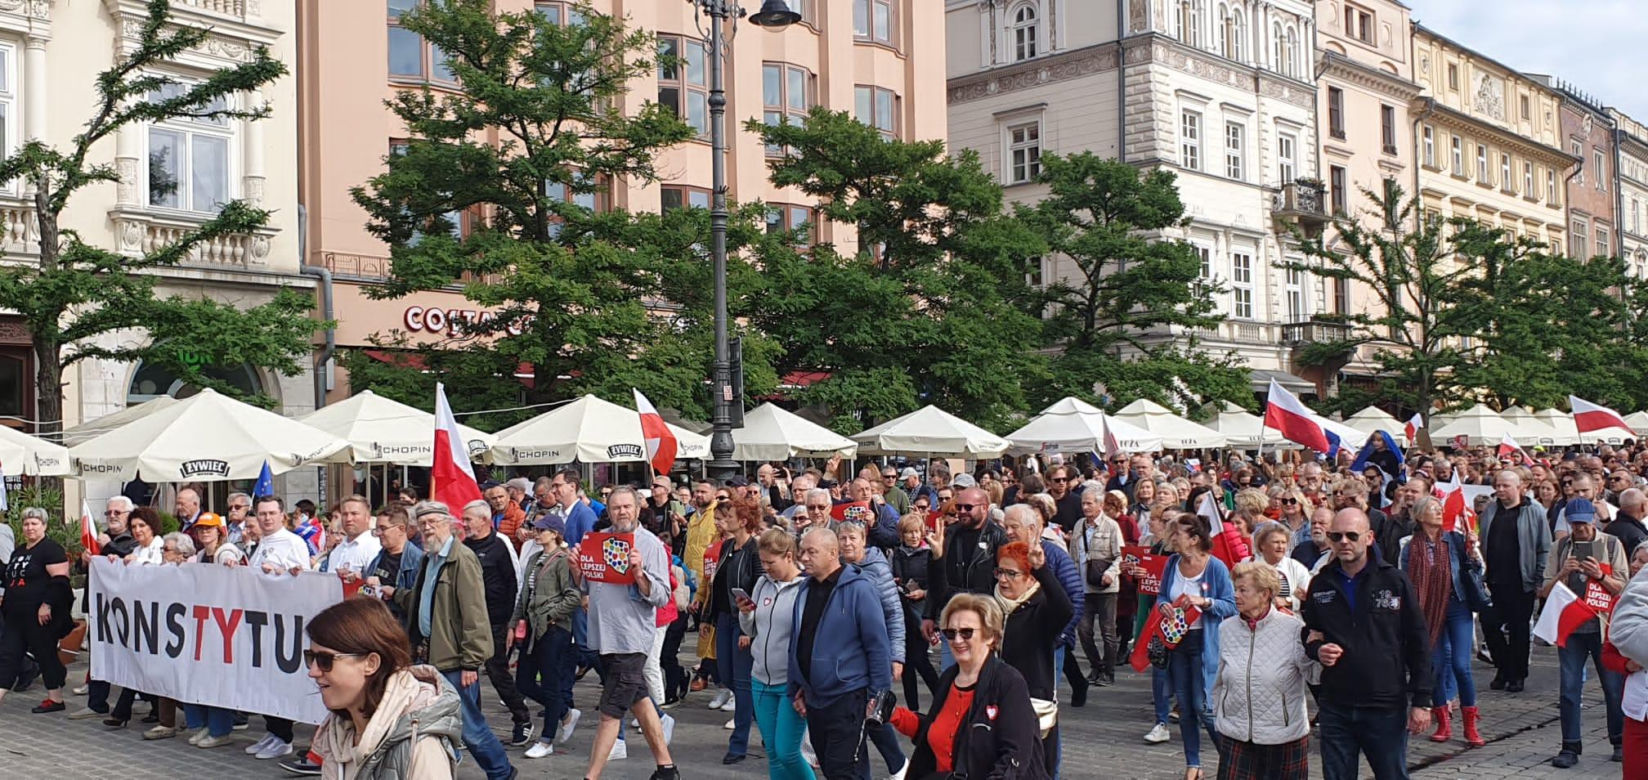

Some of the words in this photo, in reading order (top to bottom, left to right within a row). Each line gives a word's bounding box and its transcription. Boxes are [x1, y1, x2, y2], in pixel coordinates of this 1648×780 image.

[382, 446, 431, 454] CHOPIN
[519, 450, 560, 459] CHOPIN
[83, 464, 123, 474] CHOPIN
[580, 554, 594, 562] DLA
